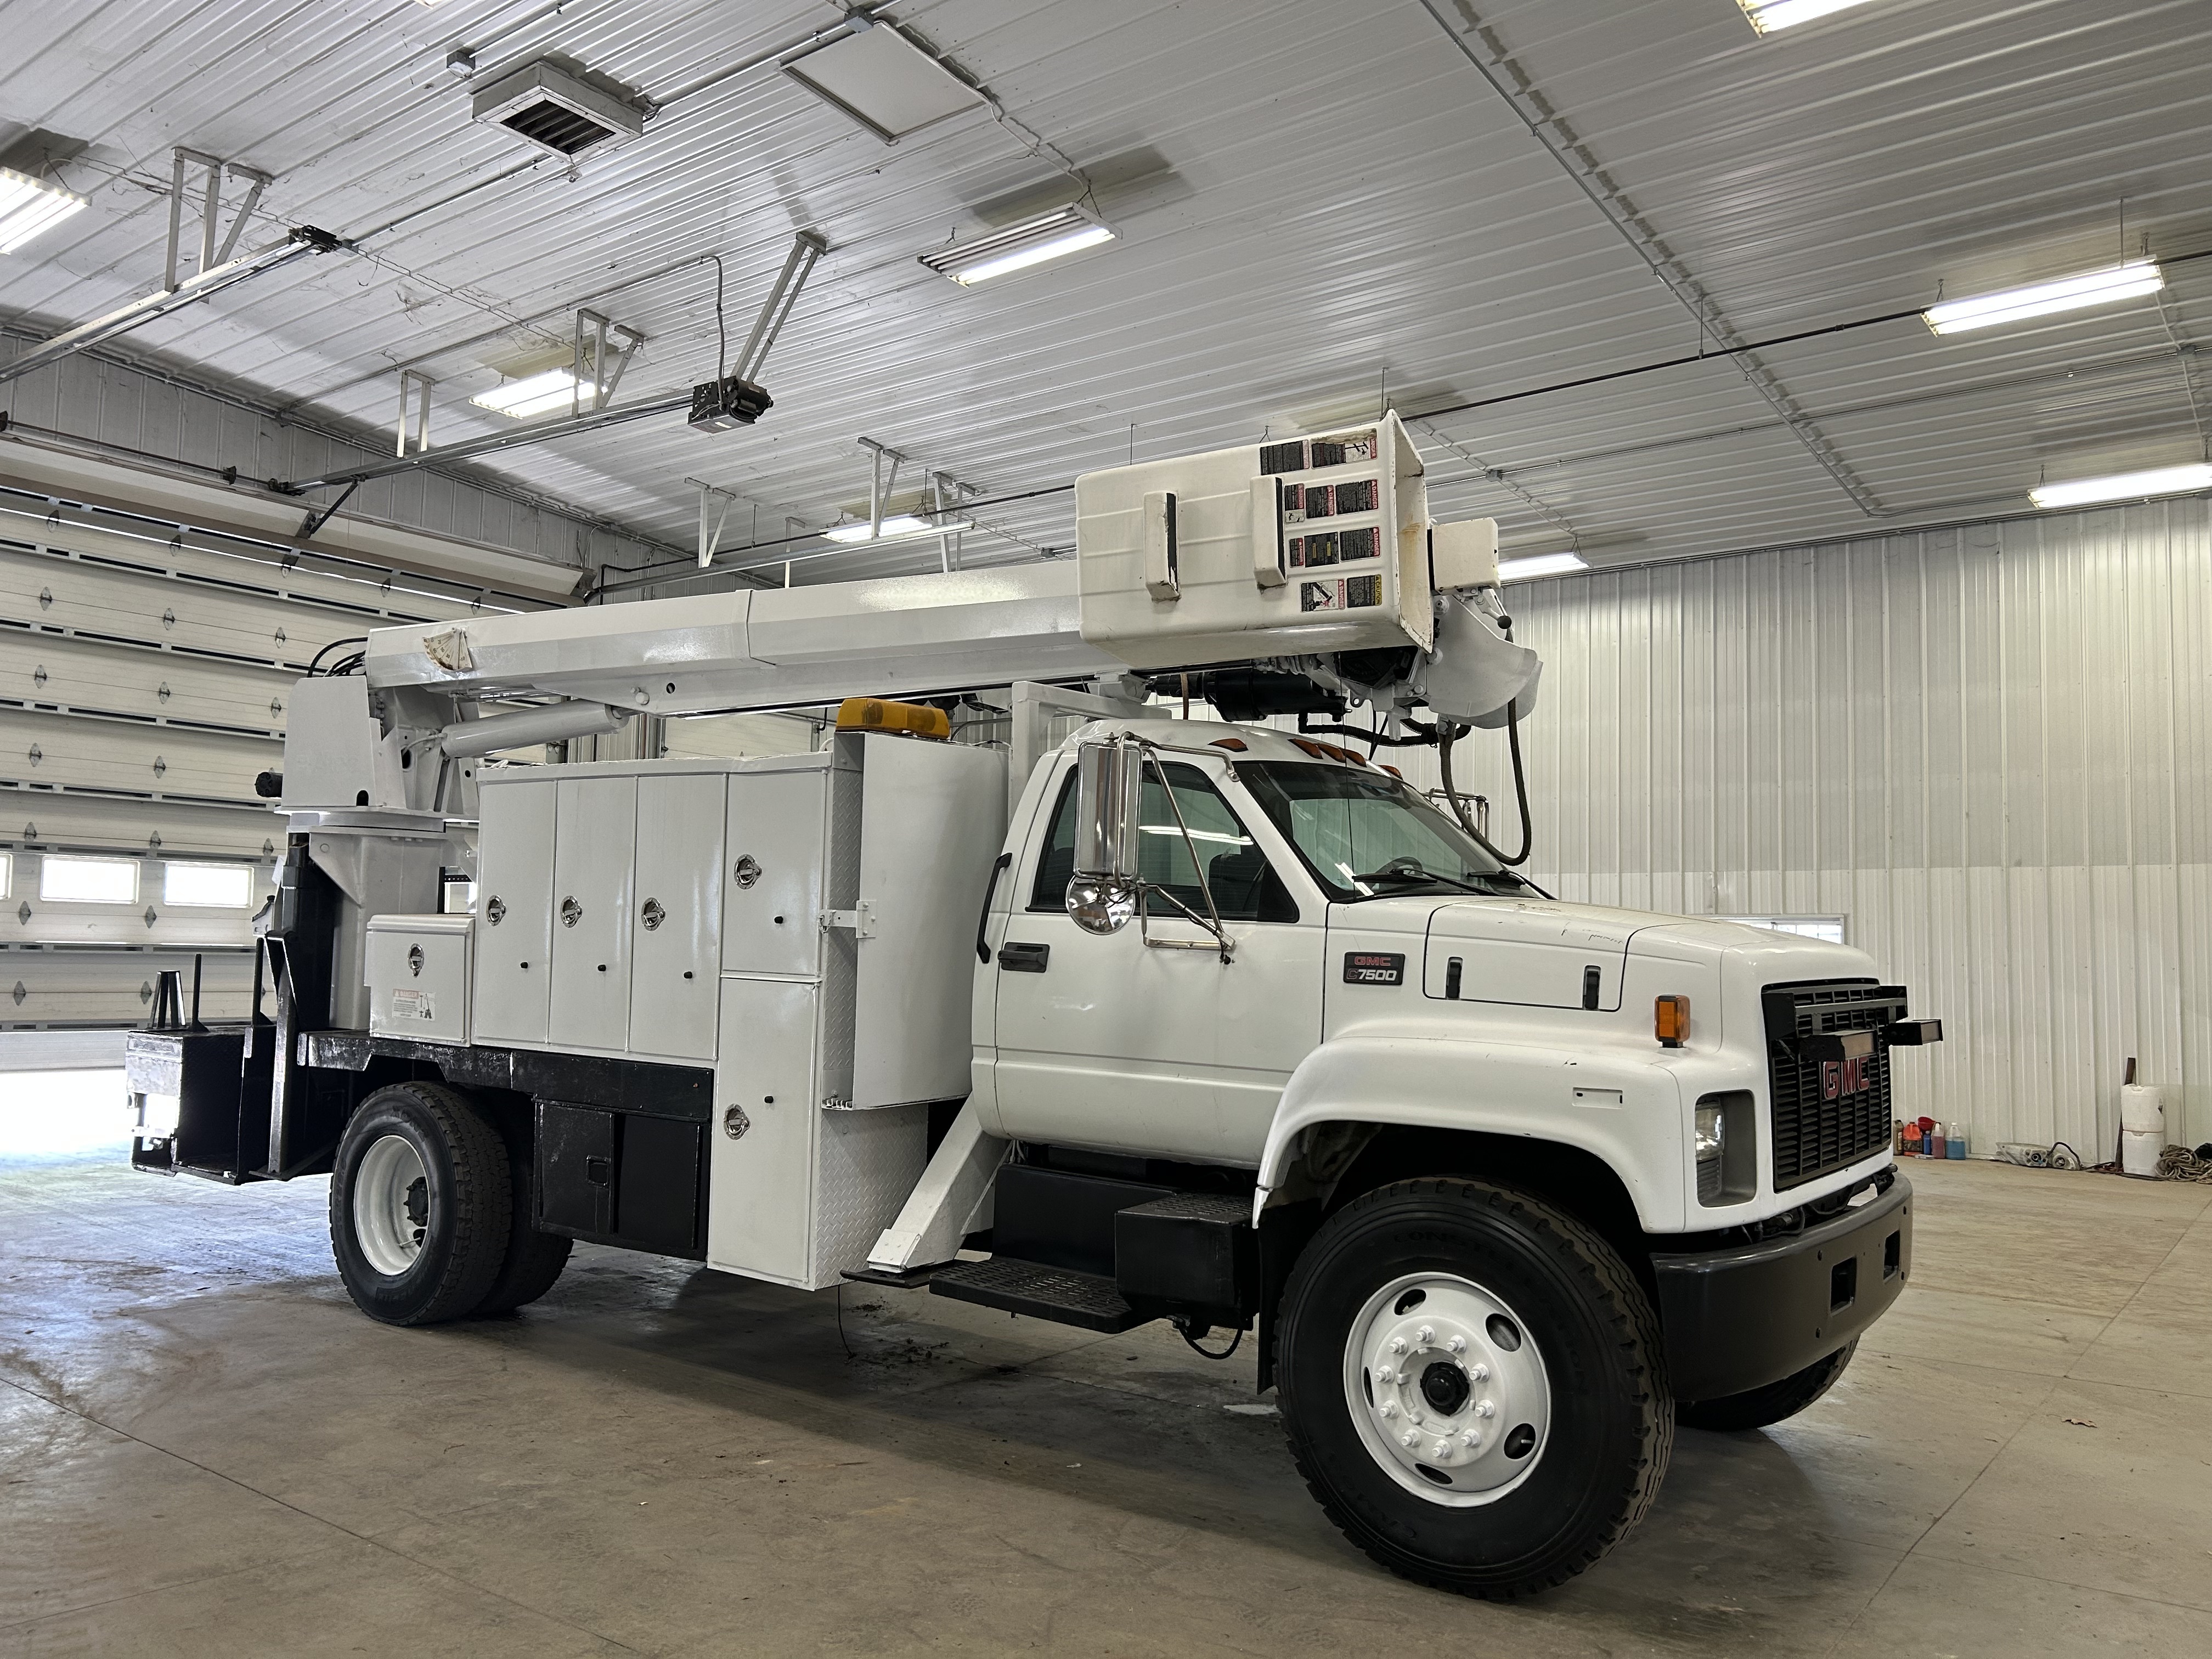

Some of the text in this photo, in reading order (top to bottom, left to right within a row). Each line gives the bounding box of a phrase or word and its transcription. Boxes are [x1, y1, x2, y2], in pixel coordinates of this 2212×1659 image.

[1354, 956, 1391, 966] GMC
[1346, 969, 1397, 981] C7500
[1823, 1056, 1870, 1099] GMC
